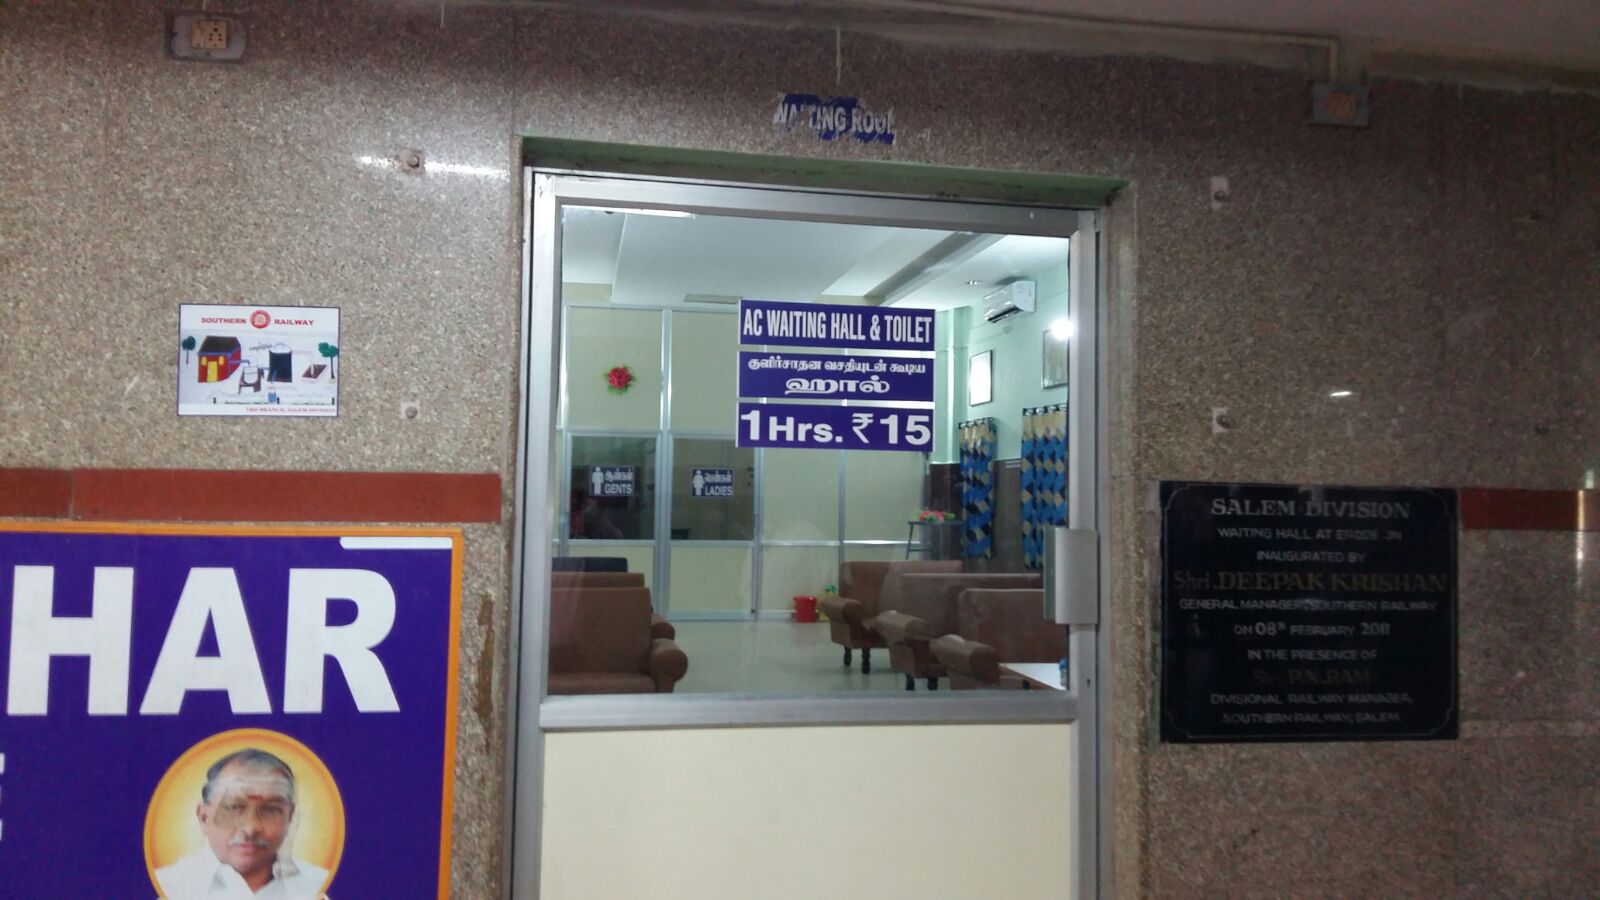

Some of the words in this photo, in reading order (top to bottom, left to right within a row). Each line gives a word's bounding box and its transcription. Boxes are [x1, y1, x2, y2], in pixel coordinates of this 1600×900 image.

[200, 317, 247, 325] SOUTHERN
[274, 318, 315, 326] RAILWAY
[743, 308, 763, 336] AC
[766, 309, 827, 339] WAITING
[830, 312, 866, 341] HALL
[869, 314, 881, 342] &
[884, 315, 932, 343] TOILET
[748, 355, 822, 371] குளிர்சாதன
[824, 357, 888, 373] வசதியுடன்
[889, 362, 926, 375] கூடிய
[784, 375, 891, 395] ஹால்
[741, 409, 761, 441] 1
[769, 416, 844, 443] Hrs.
[604, 483, 633, 494] GENTS
[704, 486, 734, 496] LADIES
[1210, 498, 1297, 517] SALEM
[1305, 501, 1412, 519] DIVISION
[1217, 527, 1273, 540] WAITING
[1275, 527, 1312, 540] HALL
[1315, 528, 1333, 540] AT
[1336, 529, 1380, 541] ERODE
[1256, 550, 1345, 563] INAUGURATED
[1347, 551, 1367, 564] BY
[1330, 572, 1449, 593] KRISHAN
[1179, 598, 1239, 611] GENERAL
[1308, 599, 1377, 612] SOUTHERN
[1380, 600, 1438, 612] RAILWAY
[1233, 624, 1253, 635] ON
[1290, 624, 1356, 636] FEBRUARY
[1360, 622, 1392, 636] 2011
[7, 565, 401, 717] HAR
[1247, 649, 1262, 660] IN
[1263, 649, 1288, 661] THE
[1291, 649, 1358, 661] PRESENCE
[1360, 649, 1378, 661] OF
[1210, 692, 1283, 705] DIVISIONAL
[1286, 693, 1346, 705] RAILWAY
[1222, 712, 1292, 725] SOUTHERN
